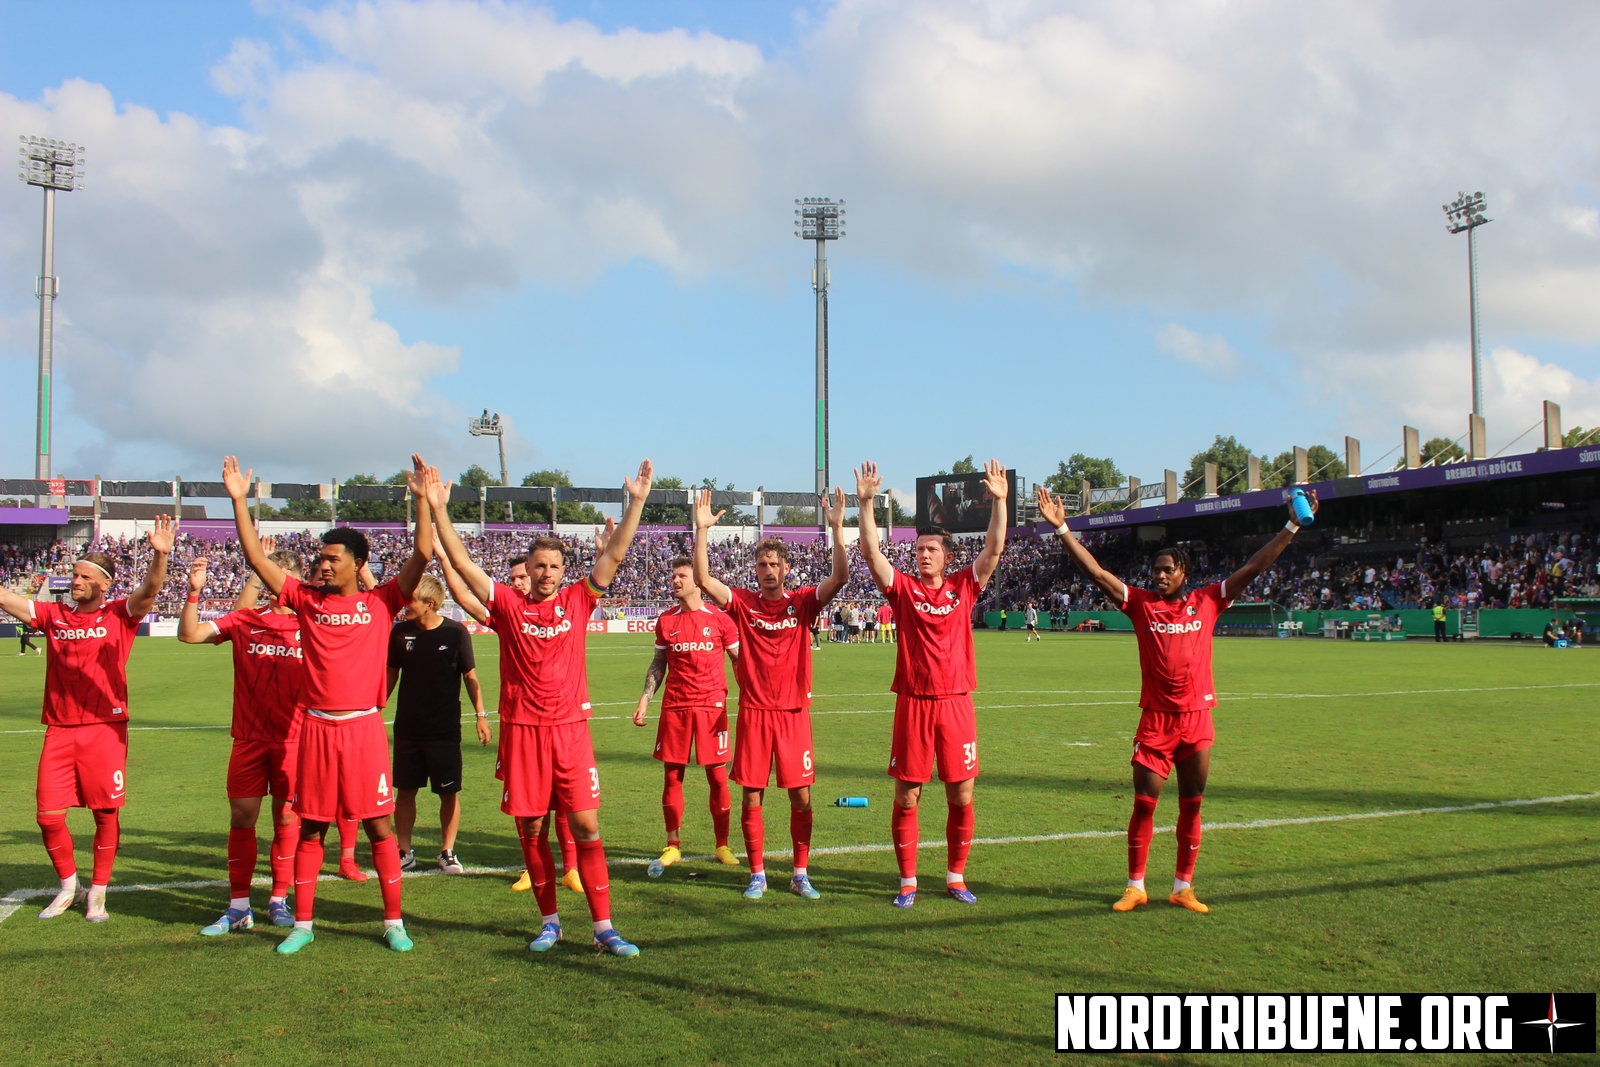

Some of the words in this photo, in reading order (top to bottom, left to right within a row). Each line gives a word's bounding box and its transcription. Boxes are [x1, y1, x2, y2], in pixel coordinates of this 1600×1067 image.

[1445, 467, 1477, 480] BREMER
[1489, 461, 1522, 475] BRÜCKE
[1195, 502, 1214, 512] BREMER
[1221, 498, 1241, 509] BRÜCKE
[914, 598, 961, 615] JOBRAD
[314, 612, 371, 626] JOBRAD
[521, 619, 571, 638] JOBRAD
[749, 617, 798, 631] JOBRAD
[1150, 620, 1202, 634] JOBRAD
[53, 626, 107, 640] JOBRAD
[669, 642, 714, 652] JOBRAD
[717, 730, 728, 750] 17
[802, 750, 812, 771] 6
[963, 741, 976, 764] 38
[113, 769, 124, 791] 9
[377, 772, 389, 797] 4
[588, 767, 600, 791] 3
